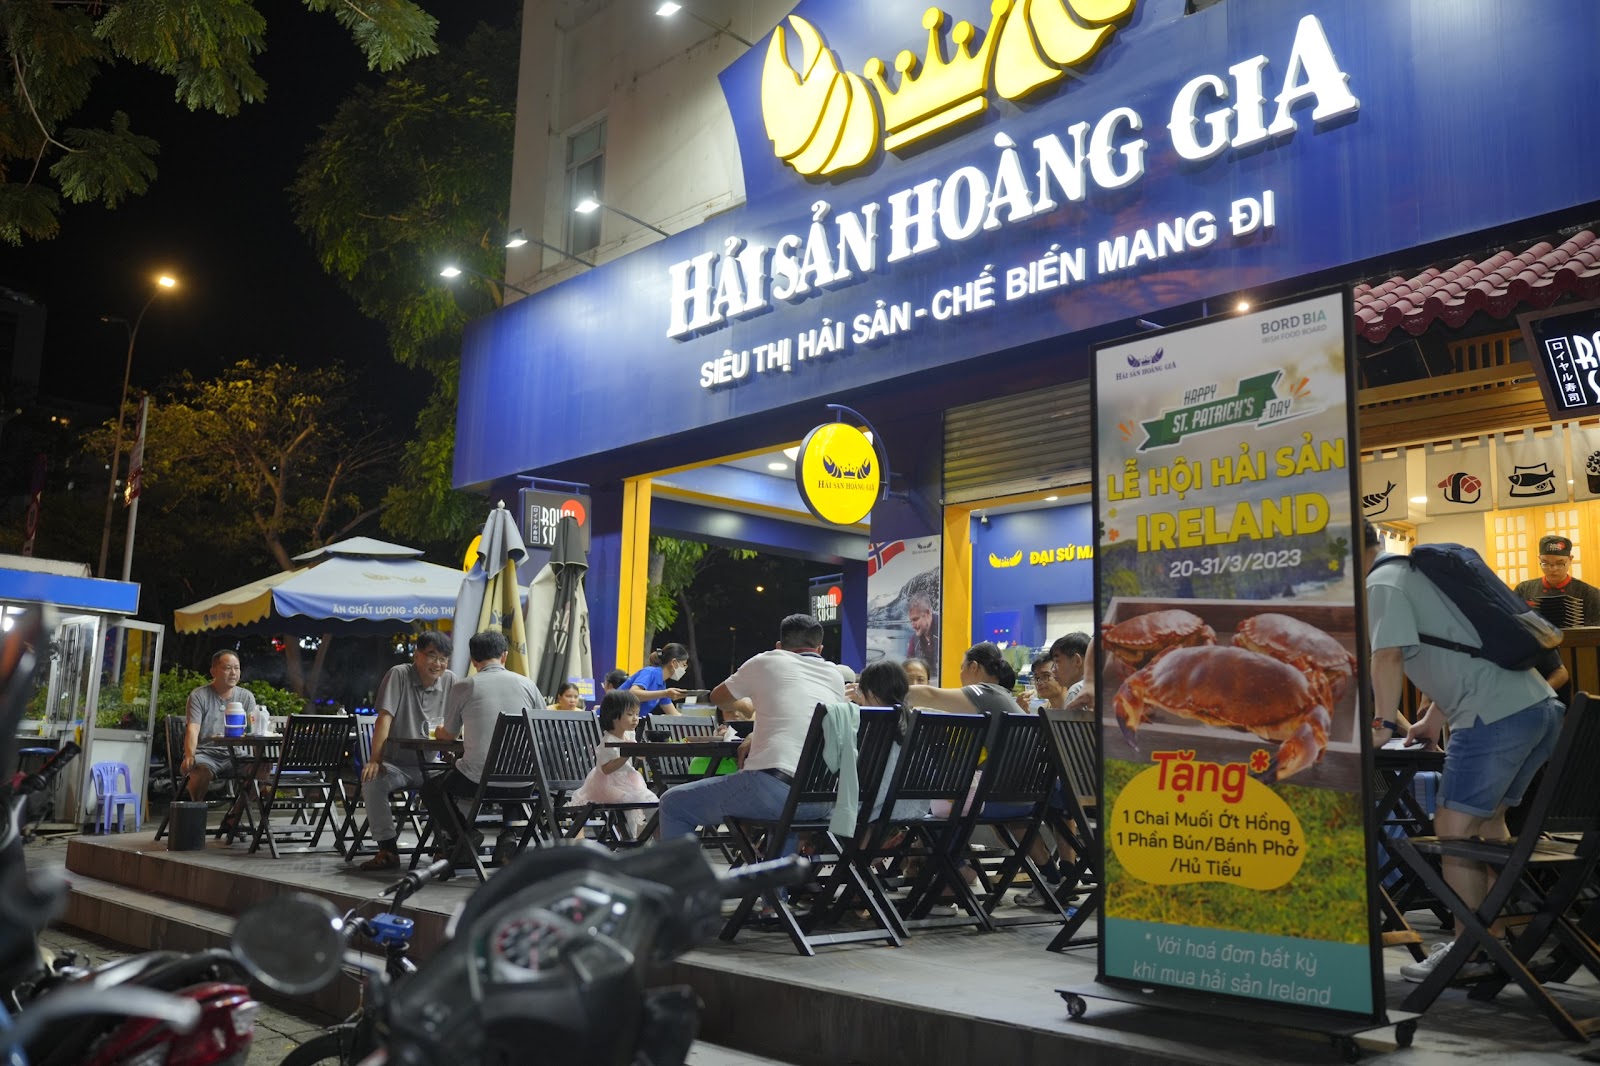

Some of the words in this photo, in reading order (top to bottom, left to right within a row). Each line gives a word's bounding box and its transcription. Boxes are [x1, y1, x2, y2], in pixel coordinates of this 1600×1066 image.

[666, 236, 769, 339] HẢI
[773, 200, 880, 300] SẢN
[887, 107, 1148, 263] HOÀNG
[1167, 14, 1360, 160] GIA
[700, 349, 749, 388] SIÊU
[753, 338, 792, 372] THỊ
[798, 318, 845, 360] HẢI
[852, 300, 911, 344] SẢN
[931, 264, 996, 321] CHẾ
[1006, 243, 1086, 300] BIẾN
[1098, 211, 1217, 273] MANG
[1229, 190, 1276, 237] ĐI
[1261, 316, 1300, 335] BORD
[1302, 310, 1327, 325] BIA
[1281, 330, 1300, 340] FOOD
[1302, 324, 1327, 336] BOARD
[1552, 341, 1580, 402] ロイヤル寿司
[1183, 384, 1218, 406] HAPPY
[1172, 414, 1189, 434] ST.
[1192, 397, 1256, 427] PATRICK'S
[1269, 399, 1292, 419] DAY
[1107, 458, 1141, 501] LỄ
[1148, 456, 1202, 500] HỘI
[1211, 442, 1267, 487] HẢI
[1275, 432, 1346, 478] SẢN
[1136, 492, 1331, 553] IRELAND
[1029, 551, 1055, 566] ĐẠI
[1056, 543, 1076, 562] SỨ
[1169, 549, 1302, 579] 20-31/3/2023
[333, 603, 347, 614] ĂN
[348, 603, 373, 615] CHẤT
[375, 605, 406, 617] LƯỢNG
[413, 603, 438, 615] SỐNG
[816, 593, 838, 609] ROYAL
[817, 607, 837, 622] SUSHI
[1122, 810, 1130, 824] 1
[1134, 810, 1169, 827] Chai
[1175, 809, 1213, 828] Muối
[1218, 808, 1240, 829] Ớt
[1246, 812, 1290, 835] Hồng
[1116, 832, 1123, 846] 1
[1128, 830, 1168, 849] Phần
[1173, 834, 1257, 855] Bún/Bánh
[1263, 839, 1299, 857] Phở
[1170, 857, 1201, 875] /Hủ
[1206, 857, 1242, 877] Tiếu
[1156, 935, 1182, 956] Với
[1185, 939, 1216, 960] hoá
[1221, 943, 1256, 965] đơn
[1260, 946, 1290, 969] bất
[1295, 952, 1318, 978] kỳ
[1133, 960, 1156, 980] khi
[1160, 968, 1195, 986] mua
[1200, 968, 1226, 990] hải
[1230, 972, 1263, 995] sản
[1267, 978, 1332, 1006] Ireland
